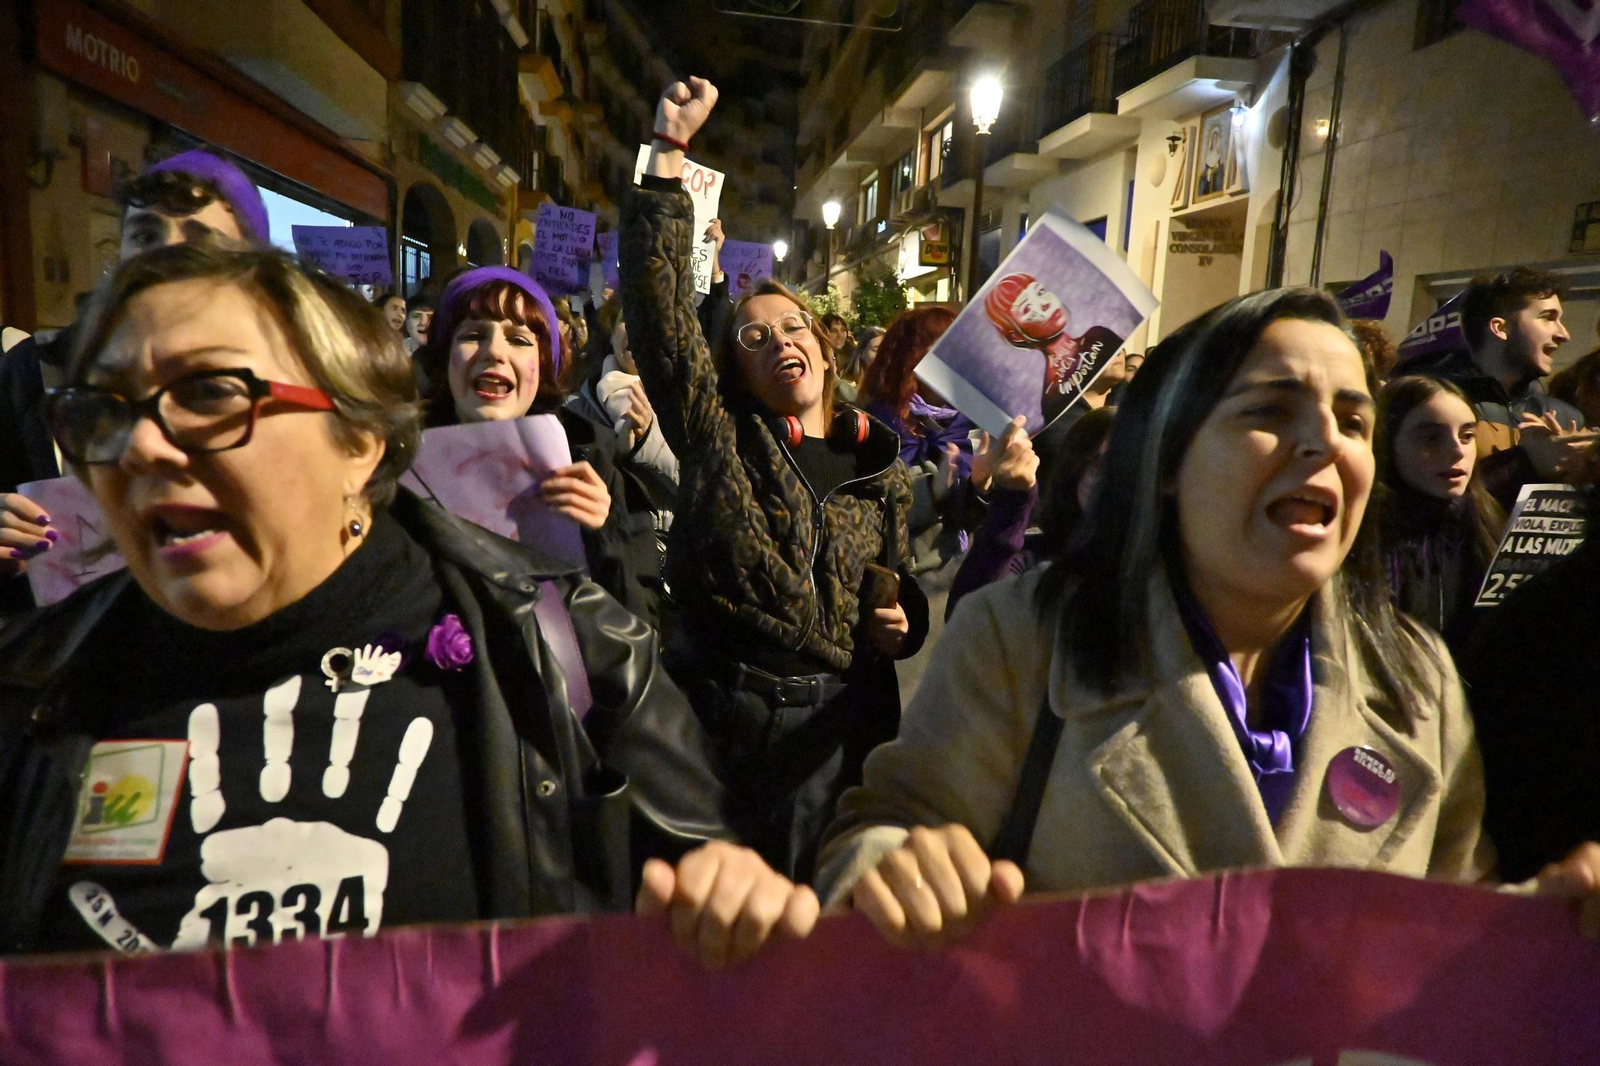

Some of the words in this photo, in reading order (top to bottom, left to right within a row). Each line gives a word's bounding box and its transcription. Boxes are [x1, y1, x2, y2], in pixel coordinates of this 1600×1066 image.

[66, 22, 140, 83] MOTRIO
[560, 209, 575, 222] NO
[536, 230, 547, 240] EL
[548, 266, 568, 277] DEL
[1522, 498, 1537, 512] EL
[1500, 536, 1515, 553] A
[1514, 536, 1545, 554] LAS
[198, 875, 369, 948] 1334
